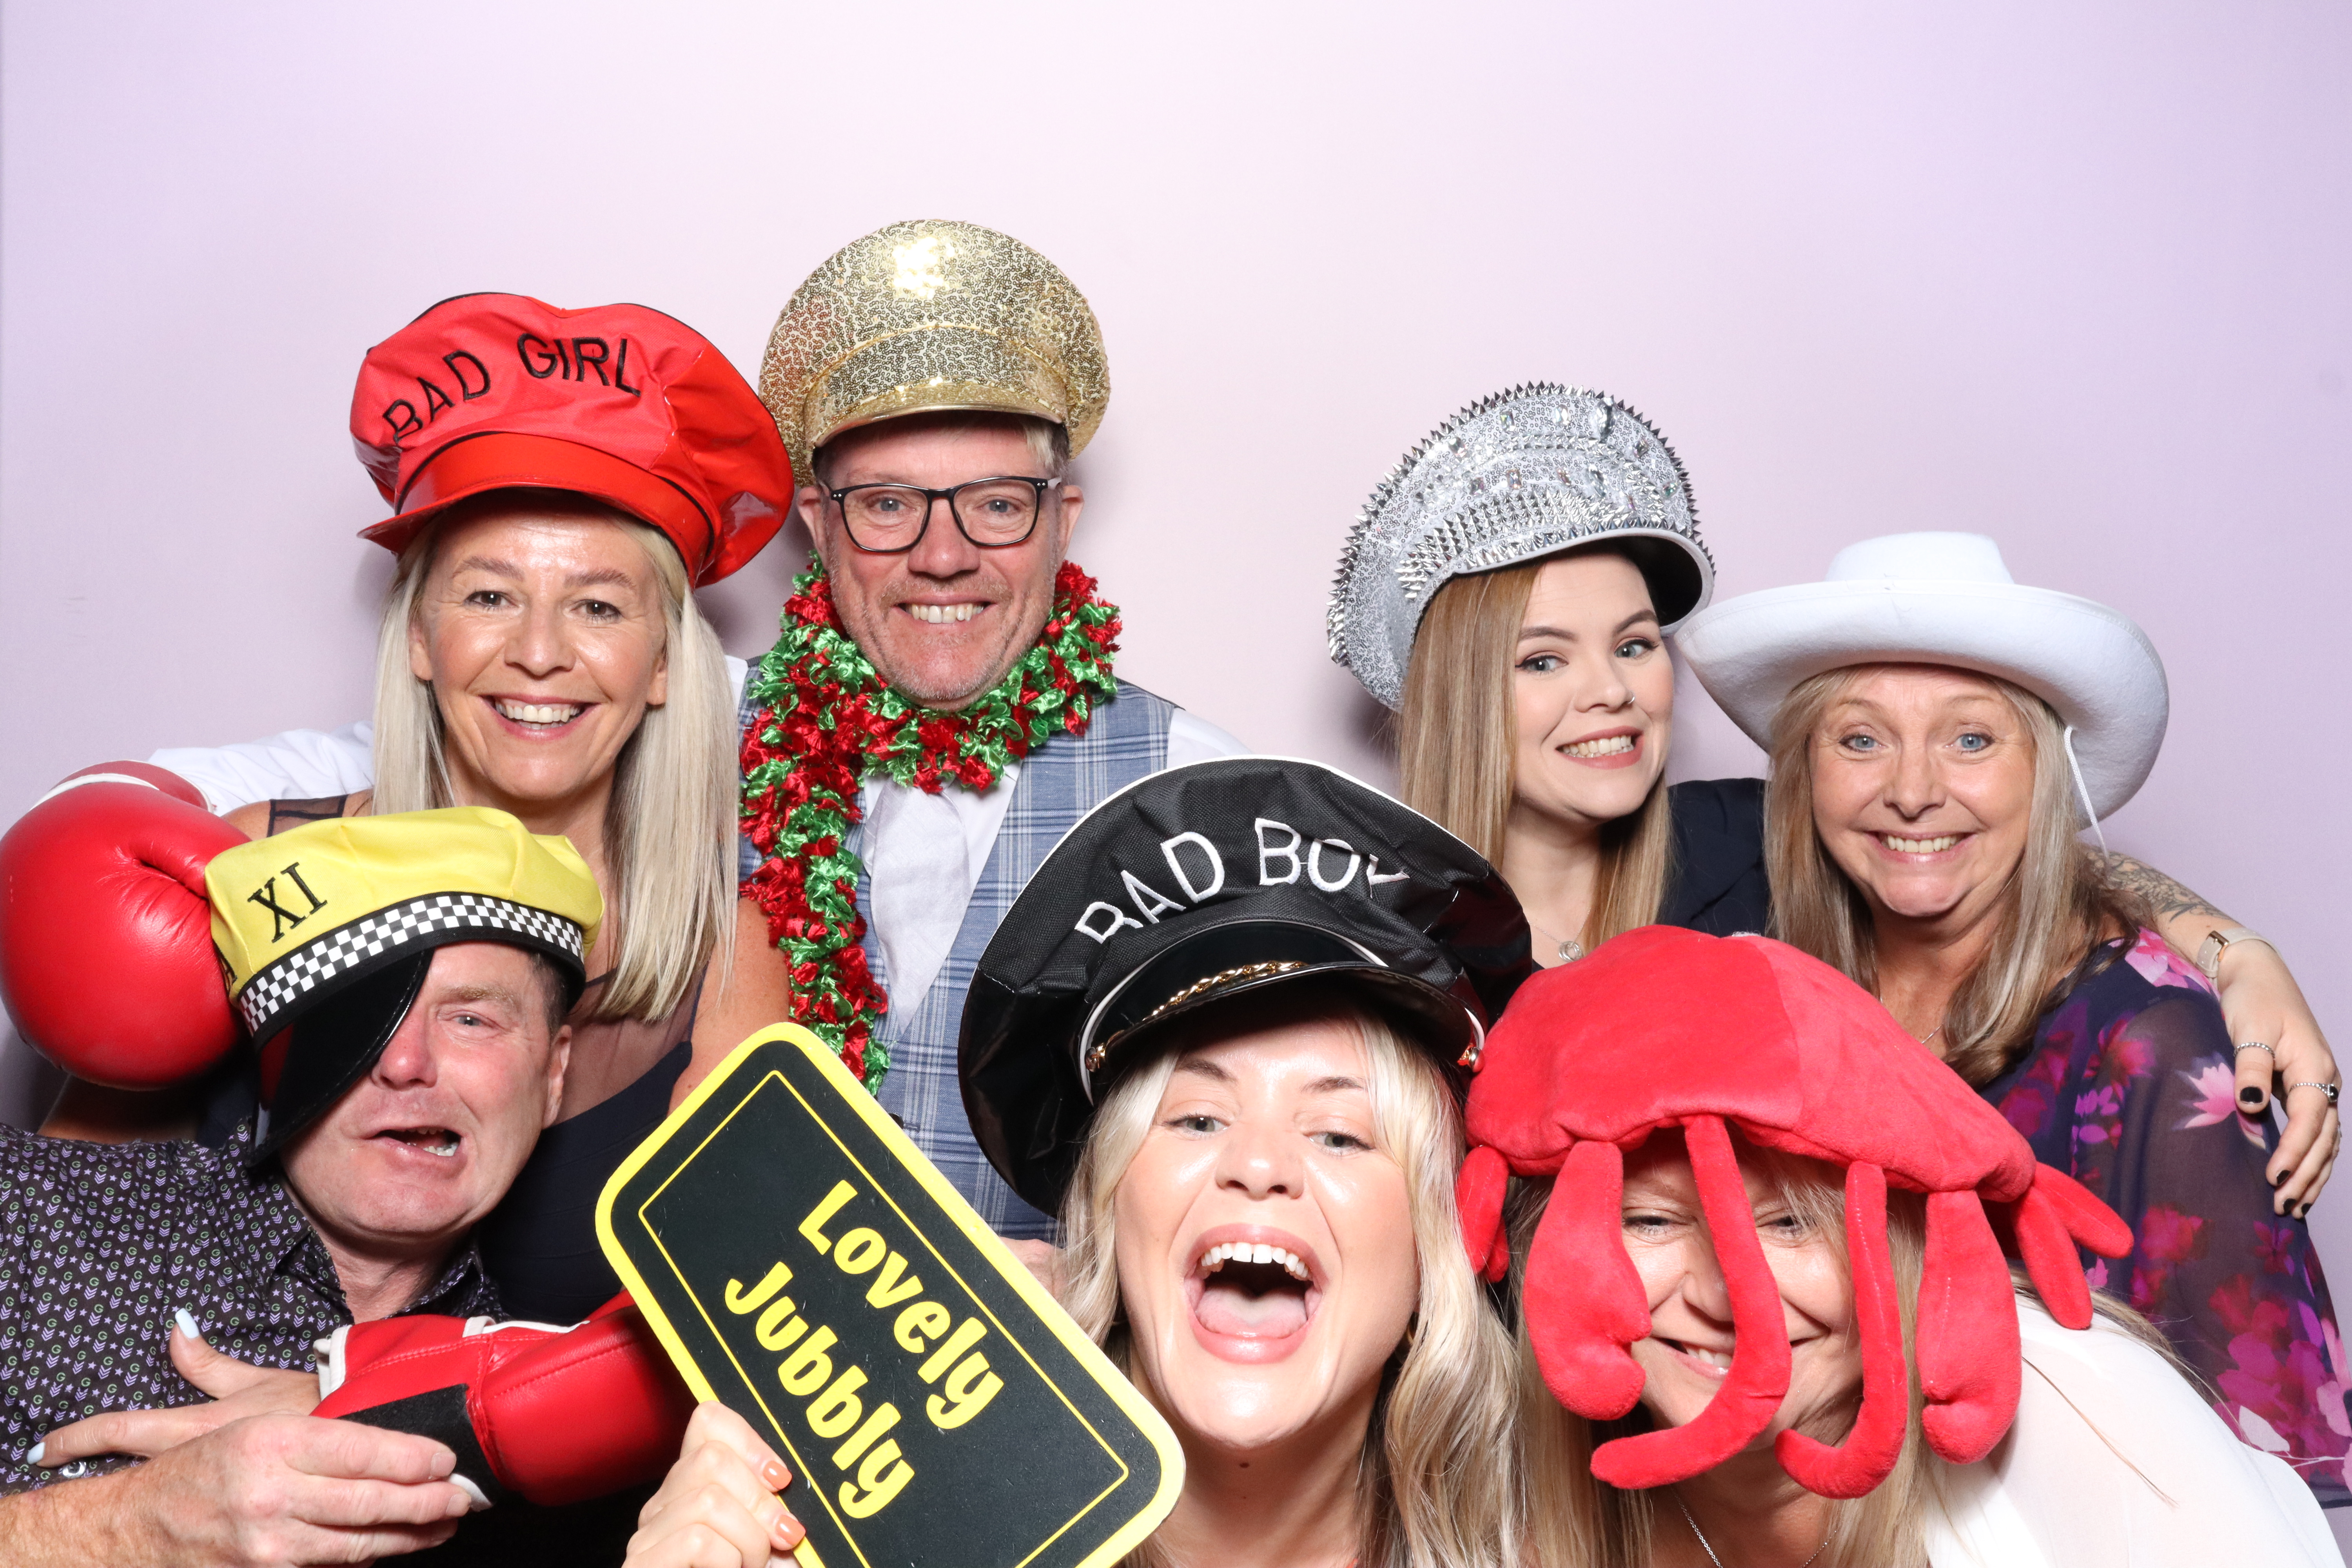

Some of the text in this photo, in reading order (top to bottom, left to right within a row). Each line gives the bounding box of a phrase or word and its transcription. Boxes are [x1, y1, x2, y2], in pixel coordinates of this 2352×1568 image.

[382, 332, 641, 444] BAD GIRL
[1074, 831, 1225, 944] BAD
[27, 1187, 35, 1196] G
[30, 1213, 38, 1222] G
[54, 1220, 64, 1228] G
[17, 1225, 25, 1234] G
[80, 1230, 87, 1239] G
[172, 1232, 180, 1241] G
[33, 1240, 42, 1249] G
[59, 1245, 68, 1254] G
[128, 1247, 137, 1255] G
[85, 1252, 94, 1260] G
[153, 1255, 162, 1263] G
[175, 1255, 183, 1263] G
[265, 1252, 272, 1261] G
[199, 1259, 207, 1268] G
[38, 1266, 47, 1275] G
[134, 1270, 142, 1279] G
[64, 1272, 73, 1280] G
[89, 1277, 99, 1286] G
[114, 1287, 123, 1296] G
[204, 1284, 211, 1292] G
[42, 1292, 52, 1301] G
[139, 1295, 148, 1303] G
[6, 1297, 14, 1306] G
[69, 1298, 77, 1307] G
[798, 1179, 1005, 1430] Lovely
[94, 1304, 103, 1313] G
[297, 1306, 305, 1314] G
[25, 1310, 31, 1319] G
[206, 1310, 215, 1318] G
[334, 1314, 340, 1323] G
[47, 1318, 57, 1327] G
[145, 1320, 153, 1328] G
[230, 1317, 239, 1325] G
[7, 1327, 16, 1336] G
[73, 1325, 82, 1334] G
[98, 1332, 107, 1340] G
[209, 1336, 218, 1344] G
[26, 1339, 34, 1348] G
[233, 1339, 242, 1348] G
[51, 1345, 62, 1354] G
[258, 1344, 267, 1353] G
[283, 1349, 291, 1357] G
[78, 1351, 86, 1360] G
[7, 1356, 16, 1365] G
[103, 1356, 113, 1365] G
[30, 1367, 39, 1376] G
[130, 1364, 140, 1372] G
[56, 1372, 65, 1381] G
[81, 1378, 91, 1387] G
[8, 1386, 18, 1396] G
[107, 1383, 117, 1393] G
[724, 1261, 915, 1519] Jubbly
[33, 1395, 43, 1405] G
[134, 1391, 142, 1400] G
[59, 1401, 68, 1409] G
[84, 1405, 93, 1414] G
[17, 1438, 27, 1447] G
[41, 1472, 51, 1480] G
